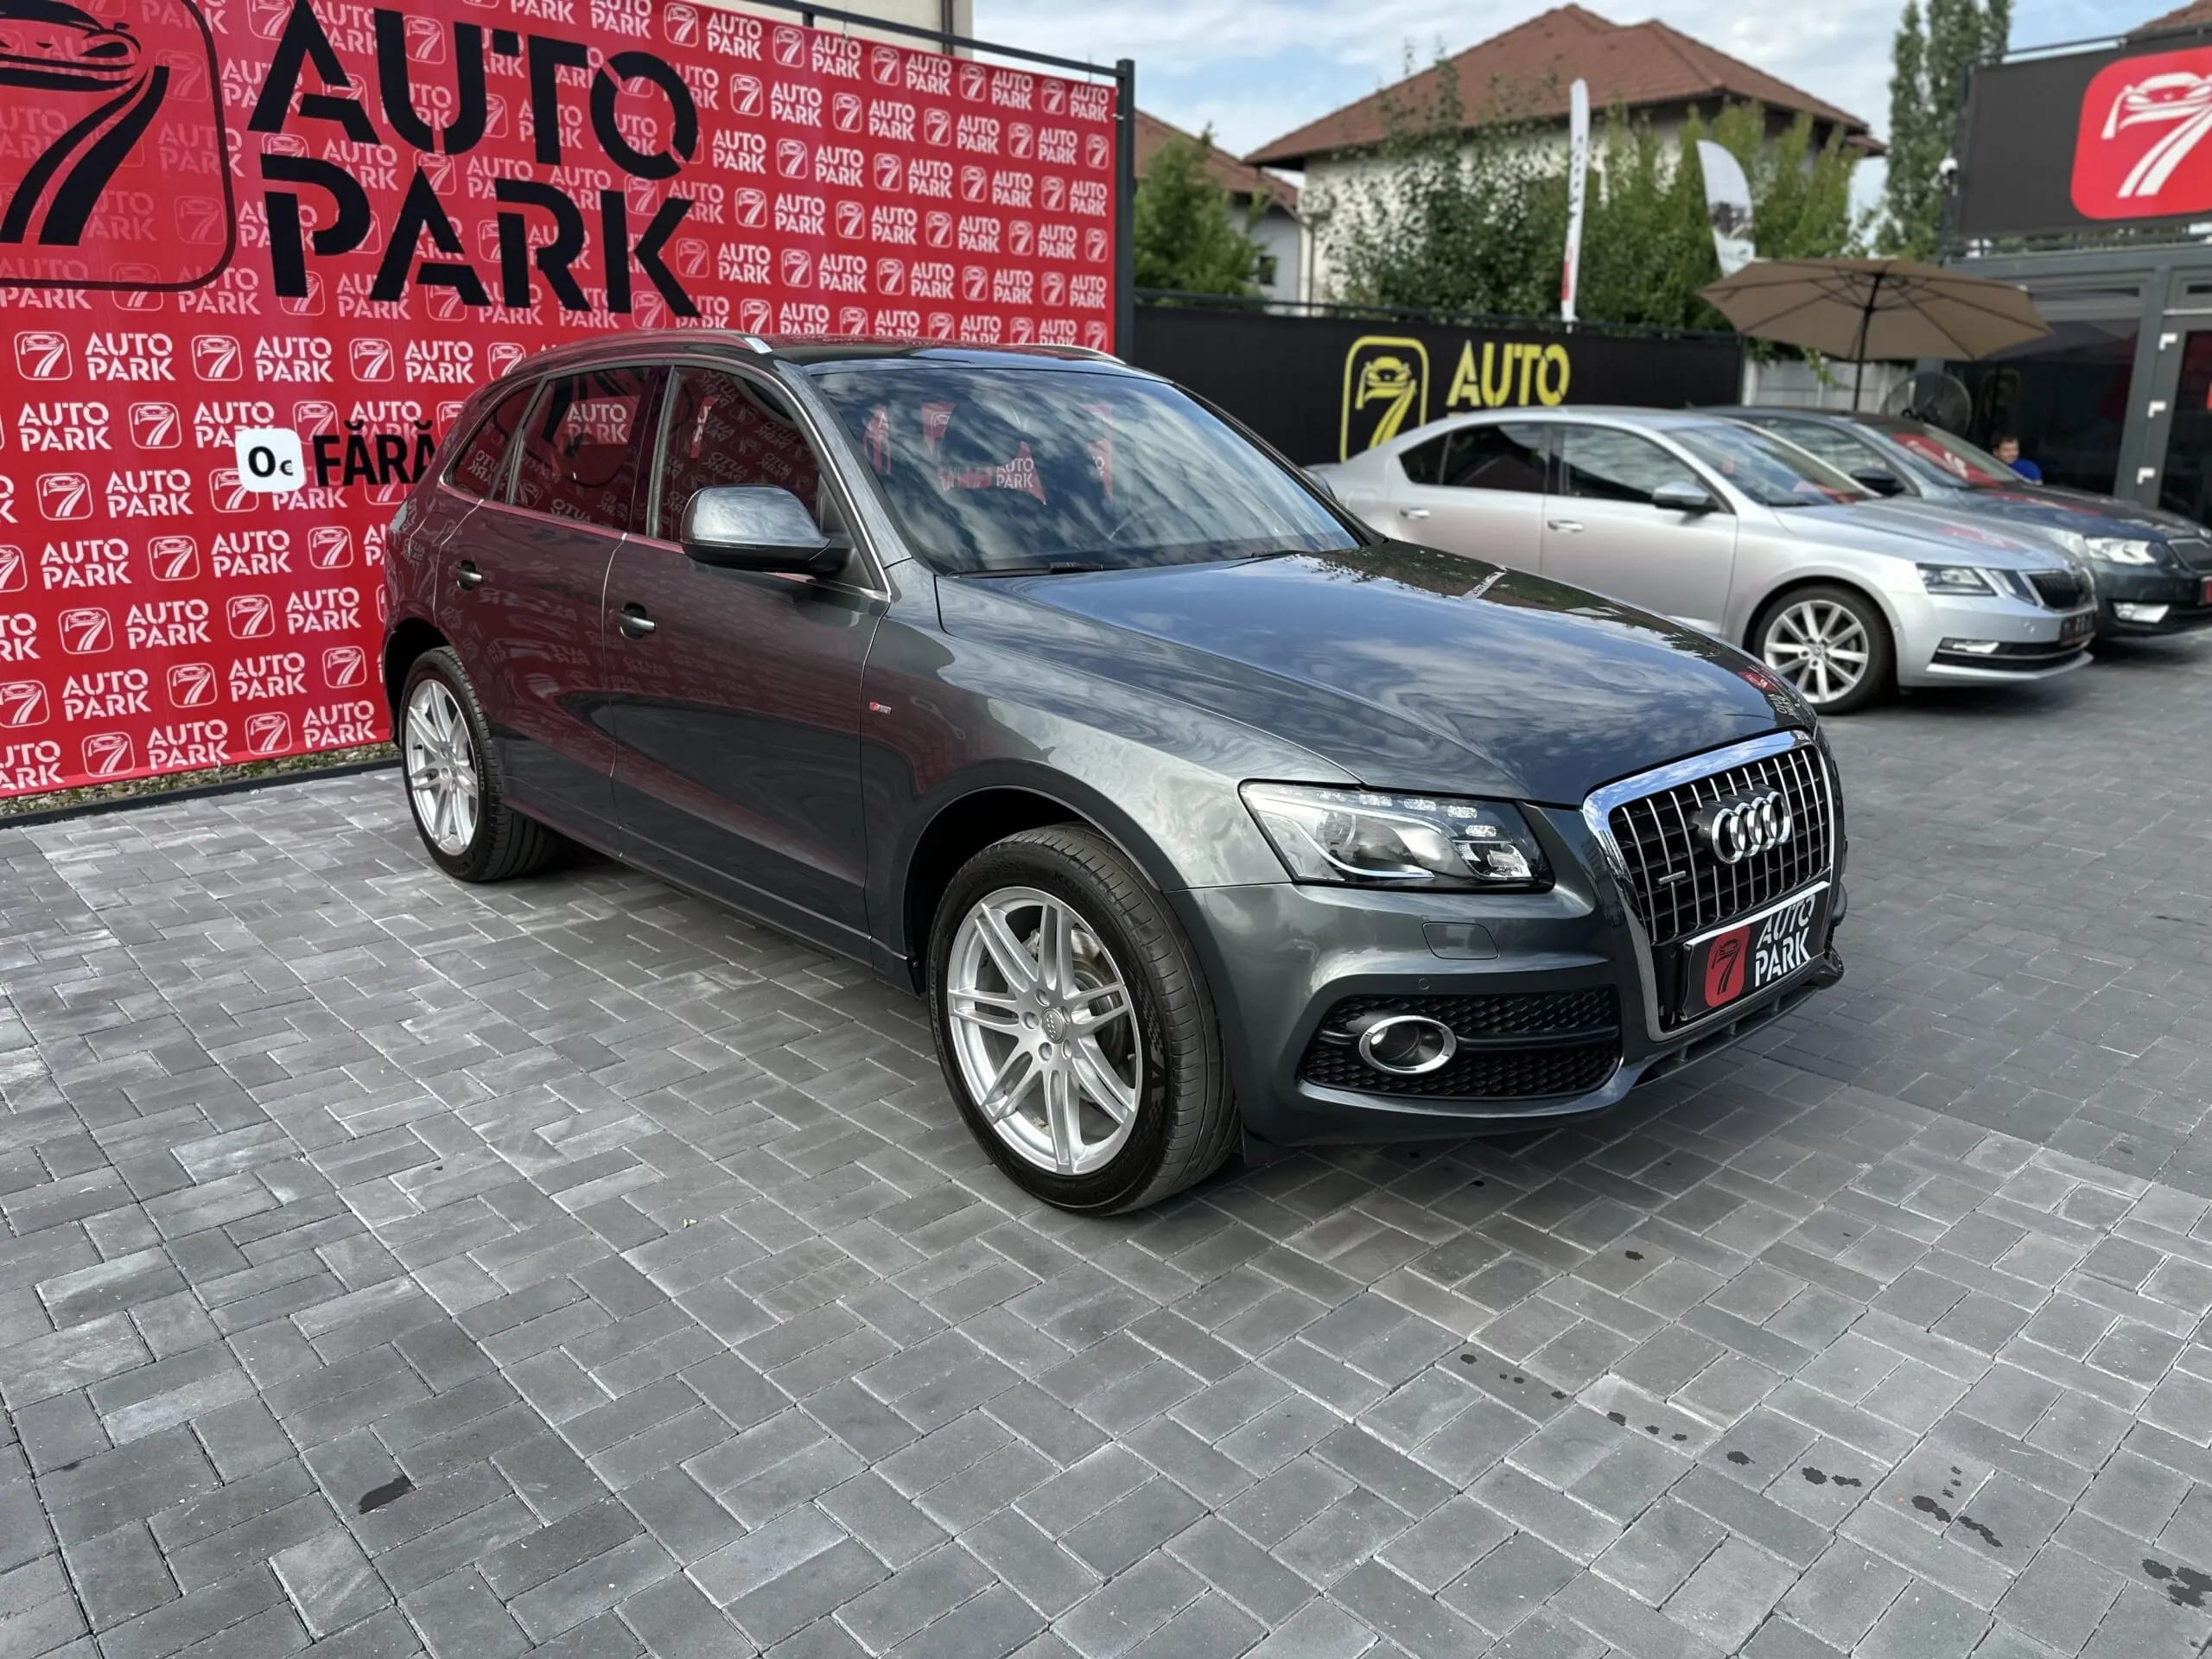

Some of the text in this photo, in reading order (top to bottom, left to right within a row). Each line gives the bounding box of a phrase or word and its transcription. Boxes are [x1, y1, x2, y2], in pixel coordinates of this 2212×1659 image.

[510, 0, 575, 24] PARK
[591, 10, 652, 39] PARK
[707, 12, 762, 39] AUTO
[323, 28, 377, 54] ARK
[708, 32, 762, 60] PARK
[812, 35, 861, 59] AUTO
[674, 64, 719, 87] UTO
[812, 54, 861, 79] PARK
[906, 54, 951, 76] AUTO
[247, 0, 698, 180] AUTO
[906, 72, 951, 96] PARK
[992, 71, 1033, 92] AUTO
[409, 83, 451, 108] UTO
[771, 81, 822, 107] AUTO
[993, 88, 1033, 111] PARK
[1071, 85, 1109, 104] AUTO
[0, 106, 67, 134] UTO
[615, 113, 657, 133] UTO
[771, 100, 822, 127] PARK
[869, 99, 914, 123] AUTO
[1071, 101, 1108, 123] PARK
[869, 118, 914, 142] PARK
[957, 114, 1000, 136] AUTO
[713, 130, 766, 154] AUTO
[957, 132, 999, 155] PARK
[1039, 128, 1077, 148] AUTO
[322, 139, 397, 166] AUTO
[713, 149, 766, 175] PARK
[816, 145, 863, 168] AUTO
[1039, 146, 1077, 165] PARK
[467, 155, 533, 181] AUTO
[550, 165, 611, 190] AUTO
[816, 163, 863, 188] PARK
[908, 159, 953, 180] AUTO
[993, 170, 1033, 190] AUTO
[669, 180, 724, 203] AUTO
[909, 178, 952, 199] PARK
[993, 188, 1032, 207] PARK
[1070, 181, 1107, 199] AUTO
[95, 190, 154, 215] UTO
[685, 201, 724, 225] ARK
[775, 194, 825, 217] AUTO
[1070, 200, 1106, 216] PARK
[776, 213, 824, 236] PARK
[872, 206, 918, 225] AUTO
[958, 216, 1000, 235] AUTO
[87, 216, 156, 242] ARK
[260, 153, 702, 317] PARK
[872, 223, 917, 245] PARK
[1039, 224, 1077, 242] AUTO
[718, 242, 771, 265] AUTO
[958, 235, 1000, 253] PARK
[1039, 242, 1076, 260] PARK
[718, 262, 771, 284] PARK
[819, 252, 867, 275] AUTO
[911, 262, 954, 281] AUTO
[820, 271, 867, 294] PARK
[911, 280, 954, 299] PARK
[994, 270, 1033, 287] AUTO
[1070, 275, 1106, 291] AUTO
[179, 292, 261, 315] PARK
[691, 295, 729, 315] UTO
[994, 287, 1033, 304] PARK
[1070, 292, 1105, 308] PARK
[338, 299, 411, 320] PARK
[479, 306, 543, 325] PARK
[560, 310, 620, 329] PARK
[780, 302, 829, 323] AUTO
[874, 309, 919, 328] AUTO
[961, 315, 1001, 332] AUTO
[1039, 320, 1077, 335] AUTO
[86, 332, 173, 356] AUTO
[254, 337, 332, 359] AUTO
[404, 340, 474, 361] AUTO
[88, 357, 175, 383] PARK
[256, 357, 334, 383] PARK
[406, 361, 474, 384] PARK
[1446, 339, 1571, 406] AUTO
[18, 401, 110, 428] AUTO
[194, 401, 275, 426] AUTO
[350, 401, 422, 423] AUTO
[567, 404, 626, 423] AUTO
[20, 428, 111, 452] PARK
[105, 469, 190, 493] AUTO
[996, 474, 1033, 489] PARK
[107, 493, 194, 518] PARK
[271, 487, 347, 511] PARK
[41, 538, 129, 564] AUTO
[211, 530, 290, 555] AUTO
[42, 562, 131, 590] PARK
[213, 552, 292, 578] PARK
[285, 587, 359, 611] AUTO
[124, 600, 209, 626] AUTO
[288, 609, 361, 634] PARK
[128, 623, 212, 649] PARK
[229, 652, 306, 679] AUTO
[62, 669, 149, 696] AUTO
[230, 676, 308, 702] PARK
[65, 694, 151, 721] PARK
[302, 700, 374, 726] AUTO
[147, 720, 228, 747] AUTO
[305, 721, 377, 748] PARK
[0, 741, 60, 767] UTO
[149, 742, 231, 771] PARK
[0, 765, 64, 789] ARK
[1756, 893, 1815, 949] AUTO
[1755, 926, 1811, 988] PARK
